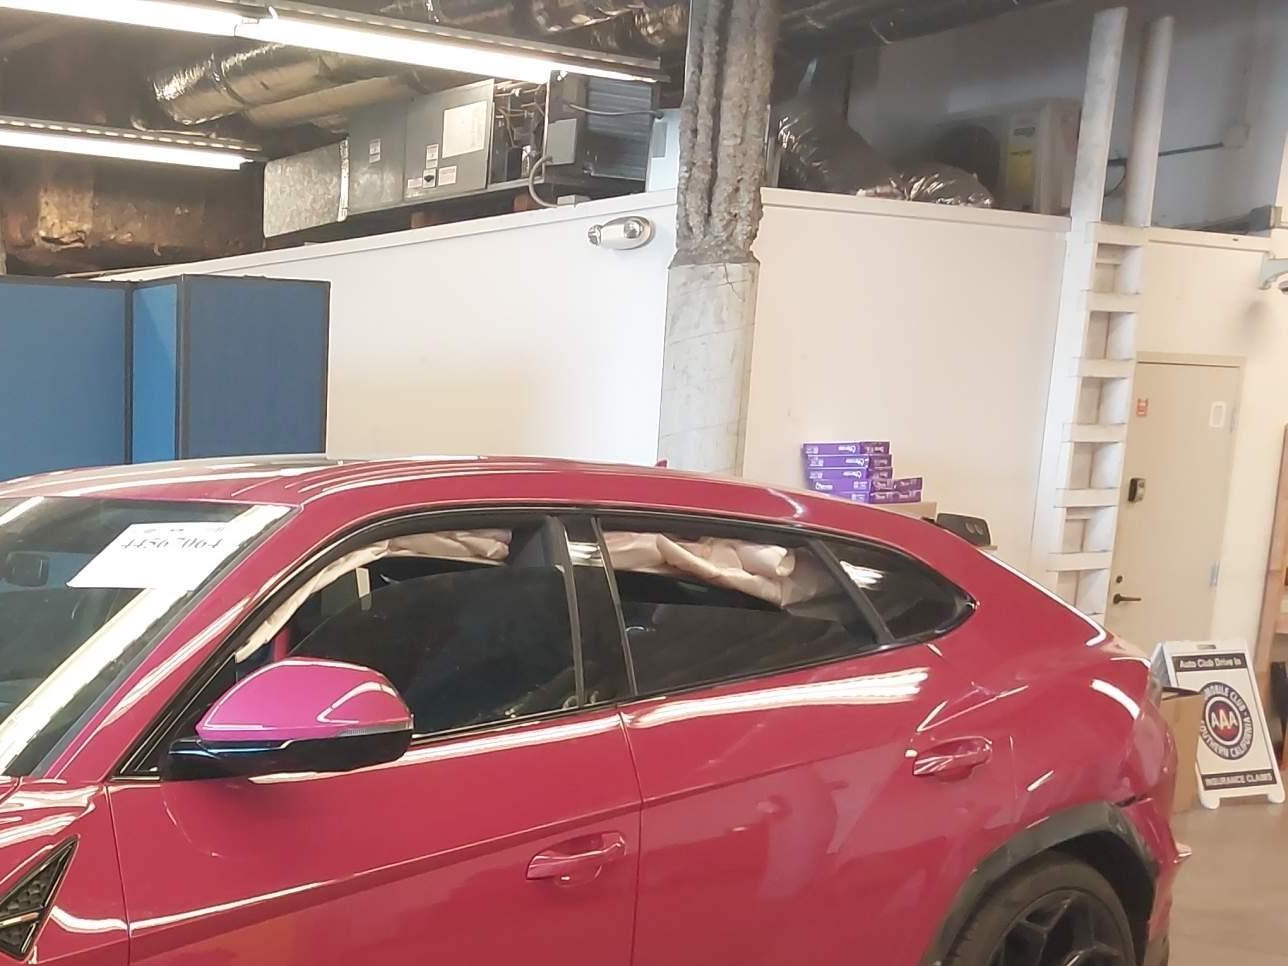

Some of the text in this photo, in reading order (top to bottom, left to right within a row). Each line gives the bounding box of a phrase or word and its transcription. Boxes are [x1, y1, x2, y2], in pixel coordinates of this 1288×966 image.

[1179, 659, 1197, 668] Auto
[1197, 658, 1214, 668] Club
[1210, 708, 1238, 731] AAA
